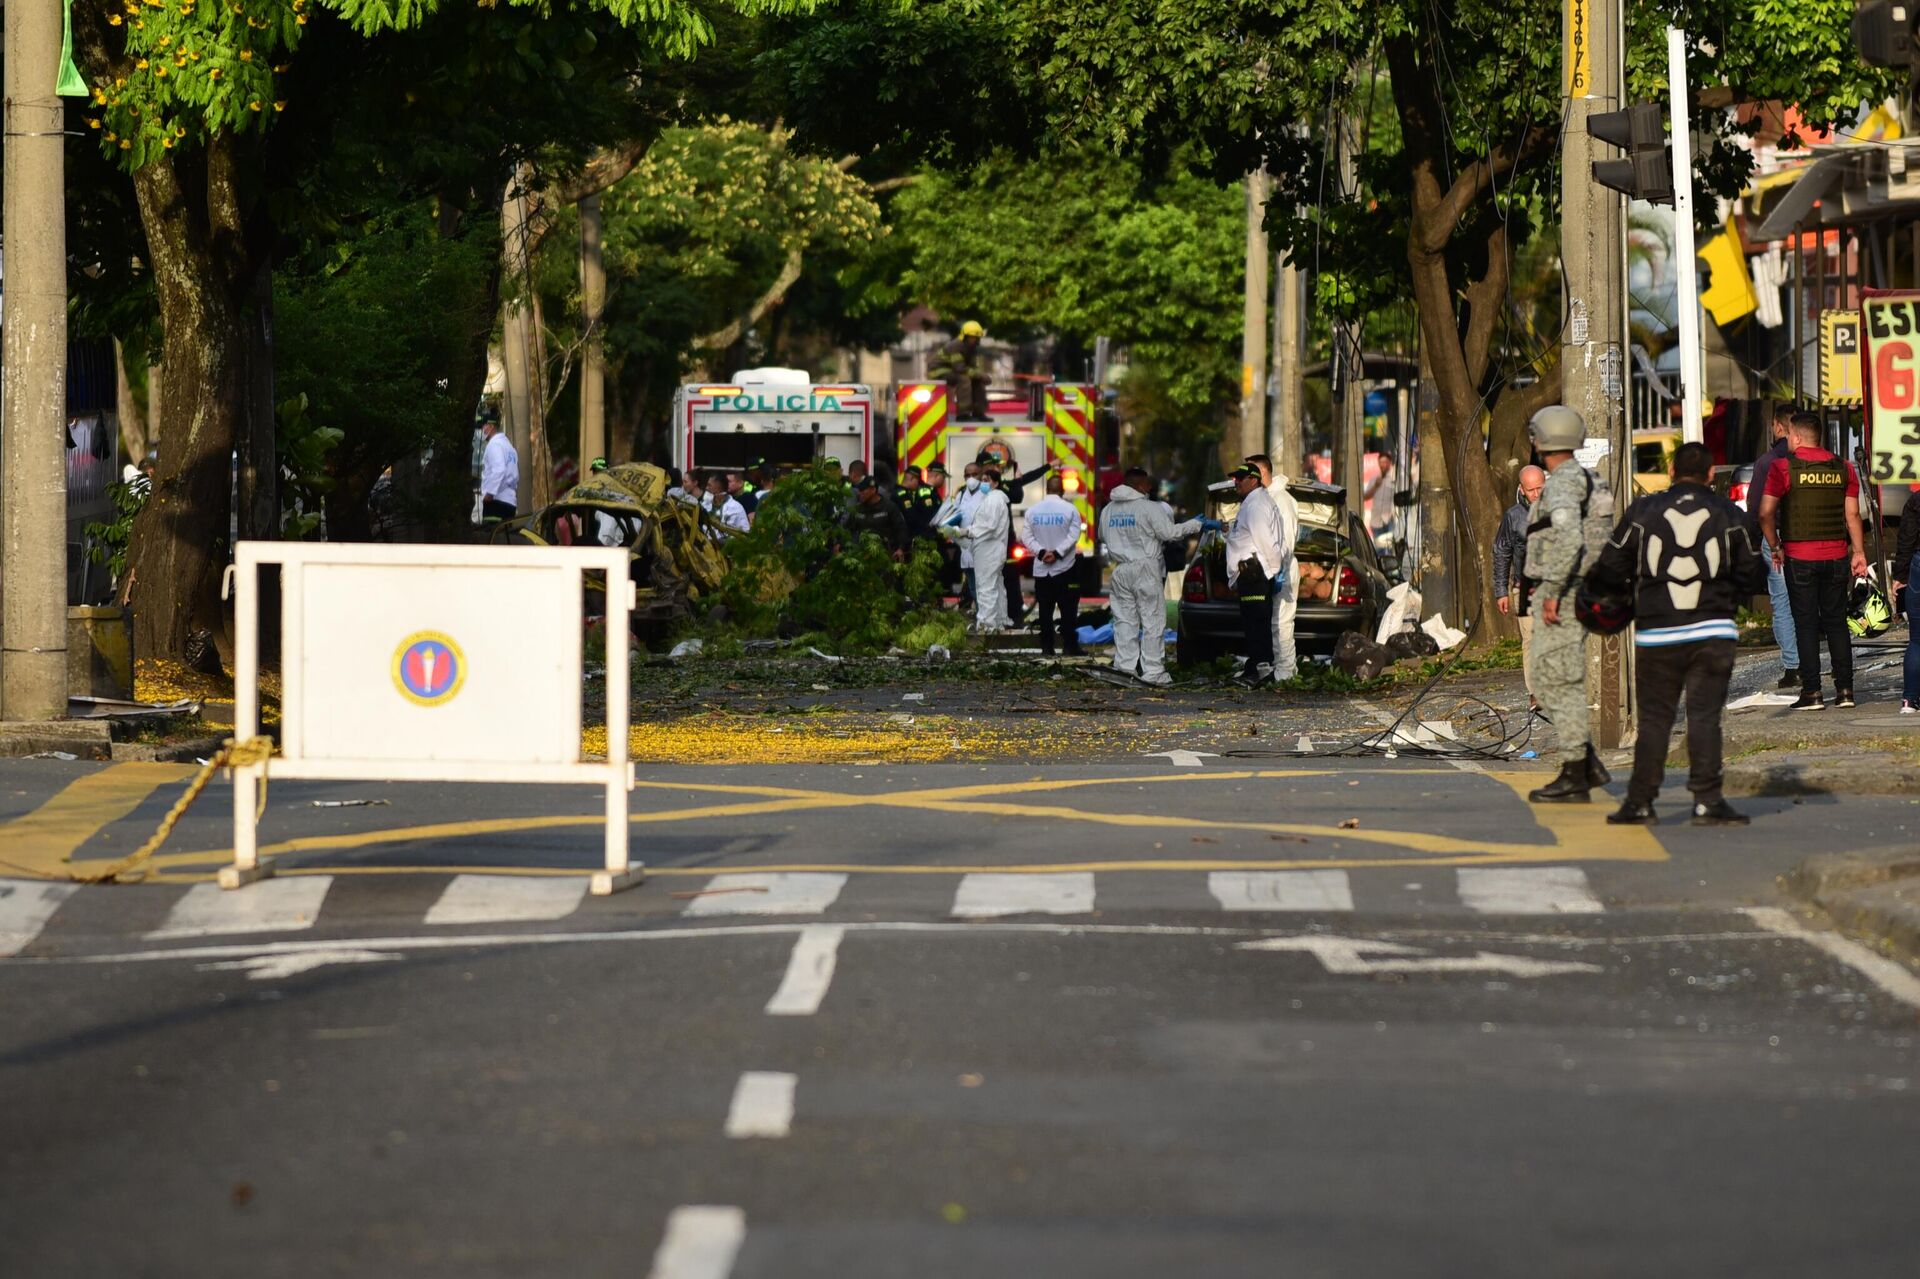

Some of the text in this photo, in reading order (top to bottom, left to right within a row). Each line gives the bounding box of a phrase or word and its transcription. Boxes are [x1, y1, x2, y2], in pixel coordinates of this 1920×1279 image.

[1573, 0, 1585, 88] 5676
[1877, 341, 1920, 410] 6
[1799, 473, 1842, 484] POLICIA
[1874, 452, 1917, 480] 32
